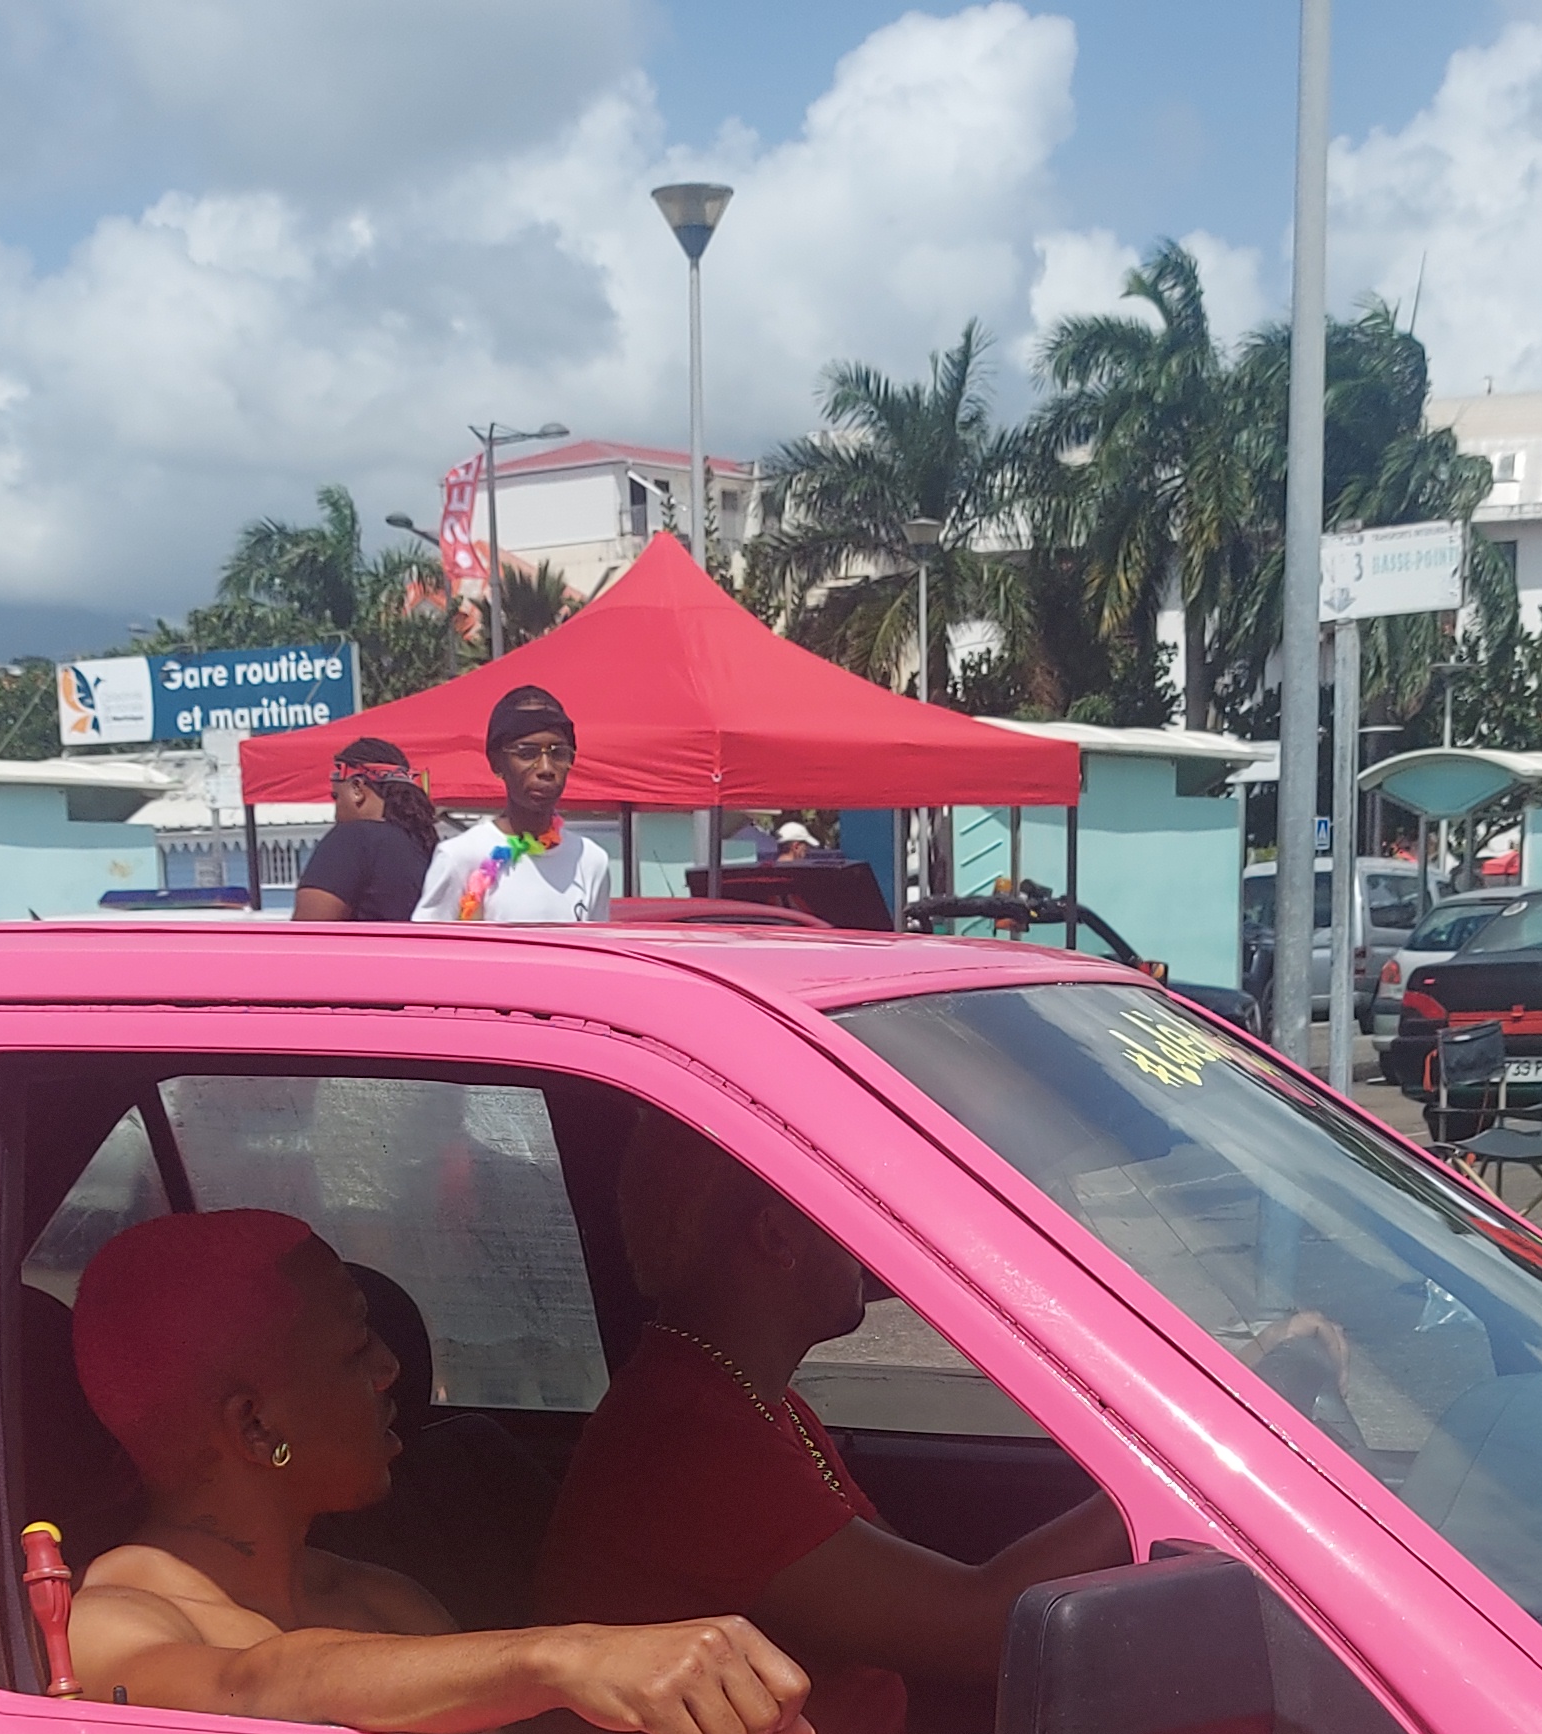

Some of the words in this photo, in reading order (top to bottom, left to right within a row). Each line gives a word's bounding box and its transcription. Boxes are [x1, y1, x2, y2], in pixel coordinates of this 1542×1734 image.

[161, 660, 229, 691] Gare
[235, 651, 343, 687] routière
[176, 705, 203, 733] et
[210, 697, 331, 730] maritime
